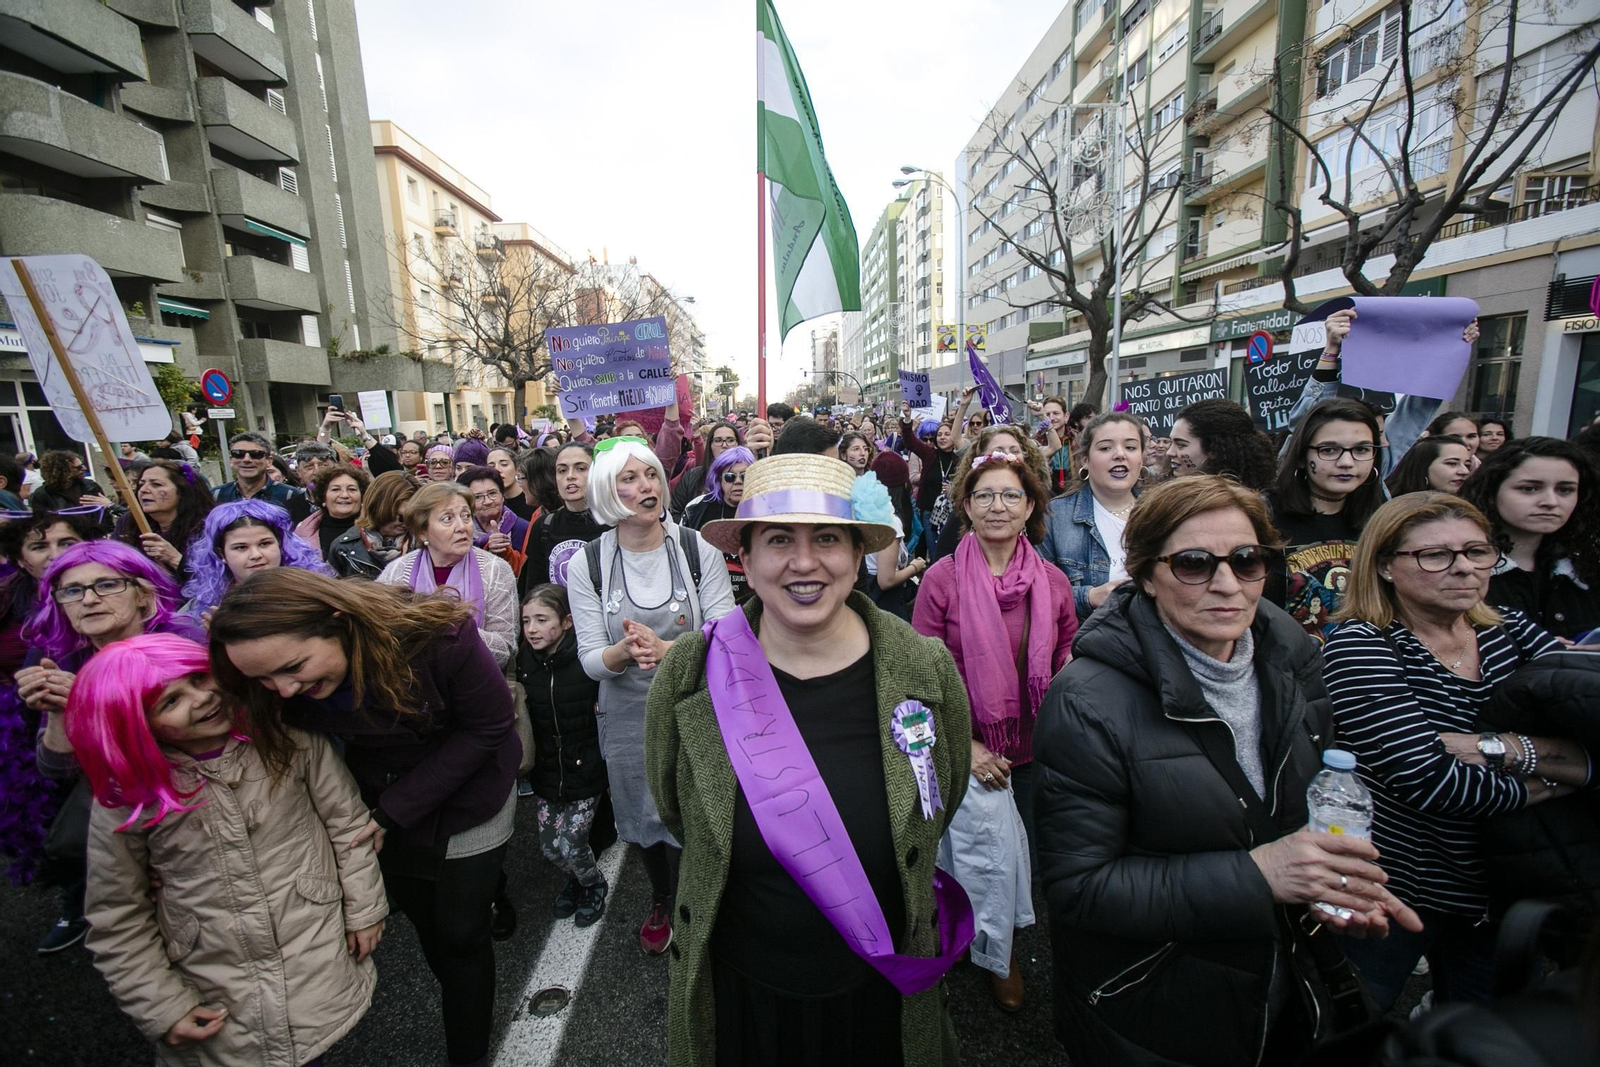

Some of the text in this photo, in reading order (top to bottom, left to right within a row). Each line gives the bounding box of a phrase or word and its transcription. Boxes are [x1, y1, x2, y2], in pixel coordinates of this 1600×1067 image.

[1231, 311, 1291, 335] Fraternidad
[551, 334, 571, 354] No
[572, 333, 600, 352] quiero
[556, 358, 574, 372] No
[576, 355, 605, 374] quiero
[635, 346, 645, 358] de
[1249, 354, 1317, 379] Todo lo
[559, 375, 593, 392] Quiero
[619, 372, 625, 381] a
[627, 370, 634, 381] la
[638, 367, 669, 379] CALLE
[1125, 371, 1223, 399] NOS QUITARON
[1252, 373, 1308, 395] callado
[564, 394, 589, 413] Sin
[1128, 388, 1226, 414] TANTO QUE NO NOS
[1259, 396, 1296, 417] grita
[1163, 413, 1174, 428] NI
